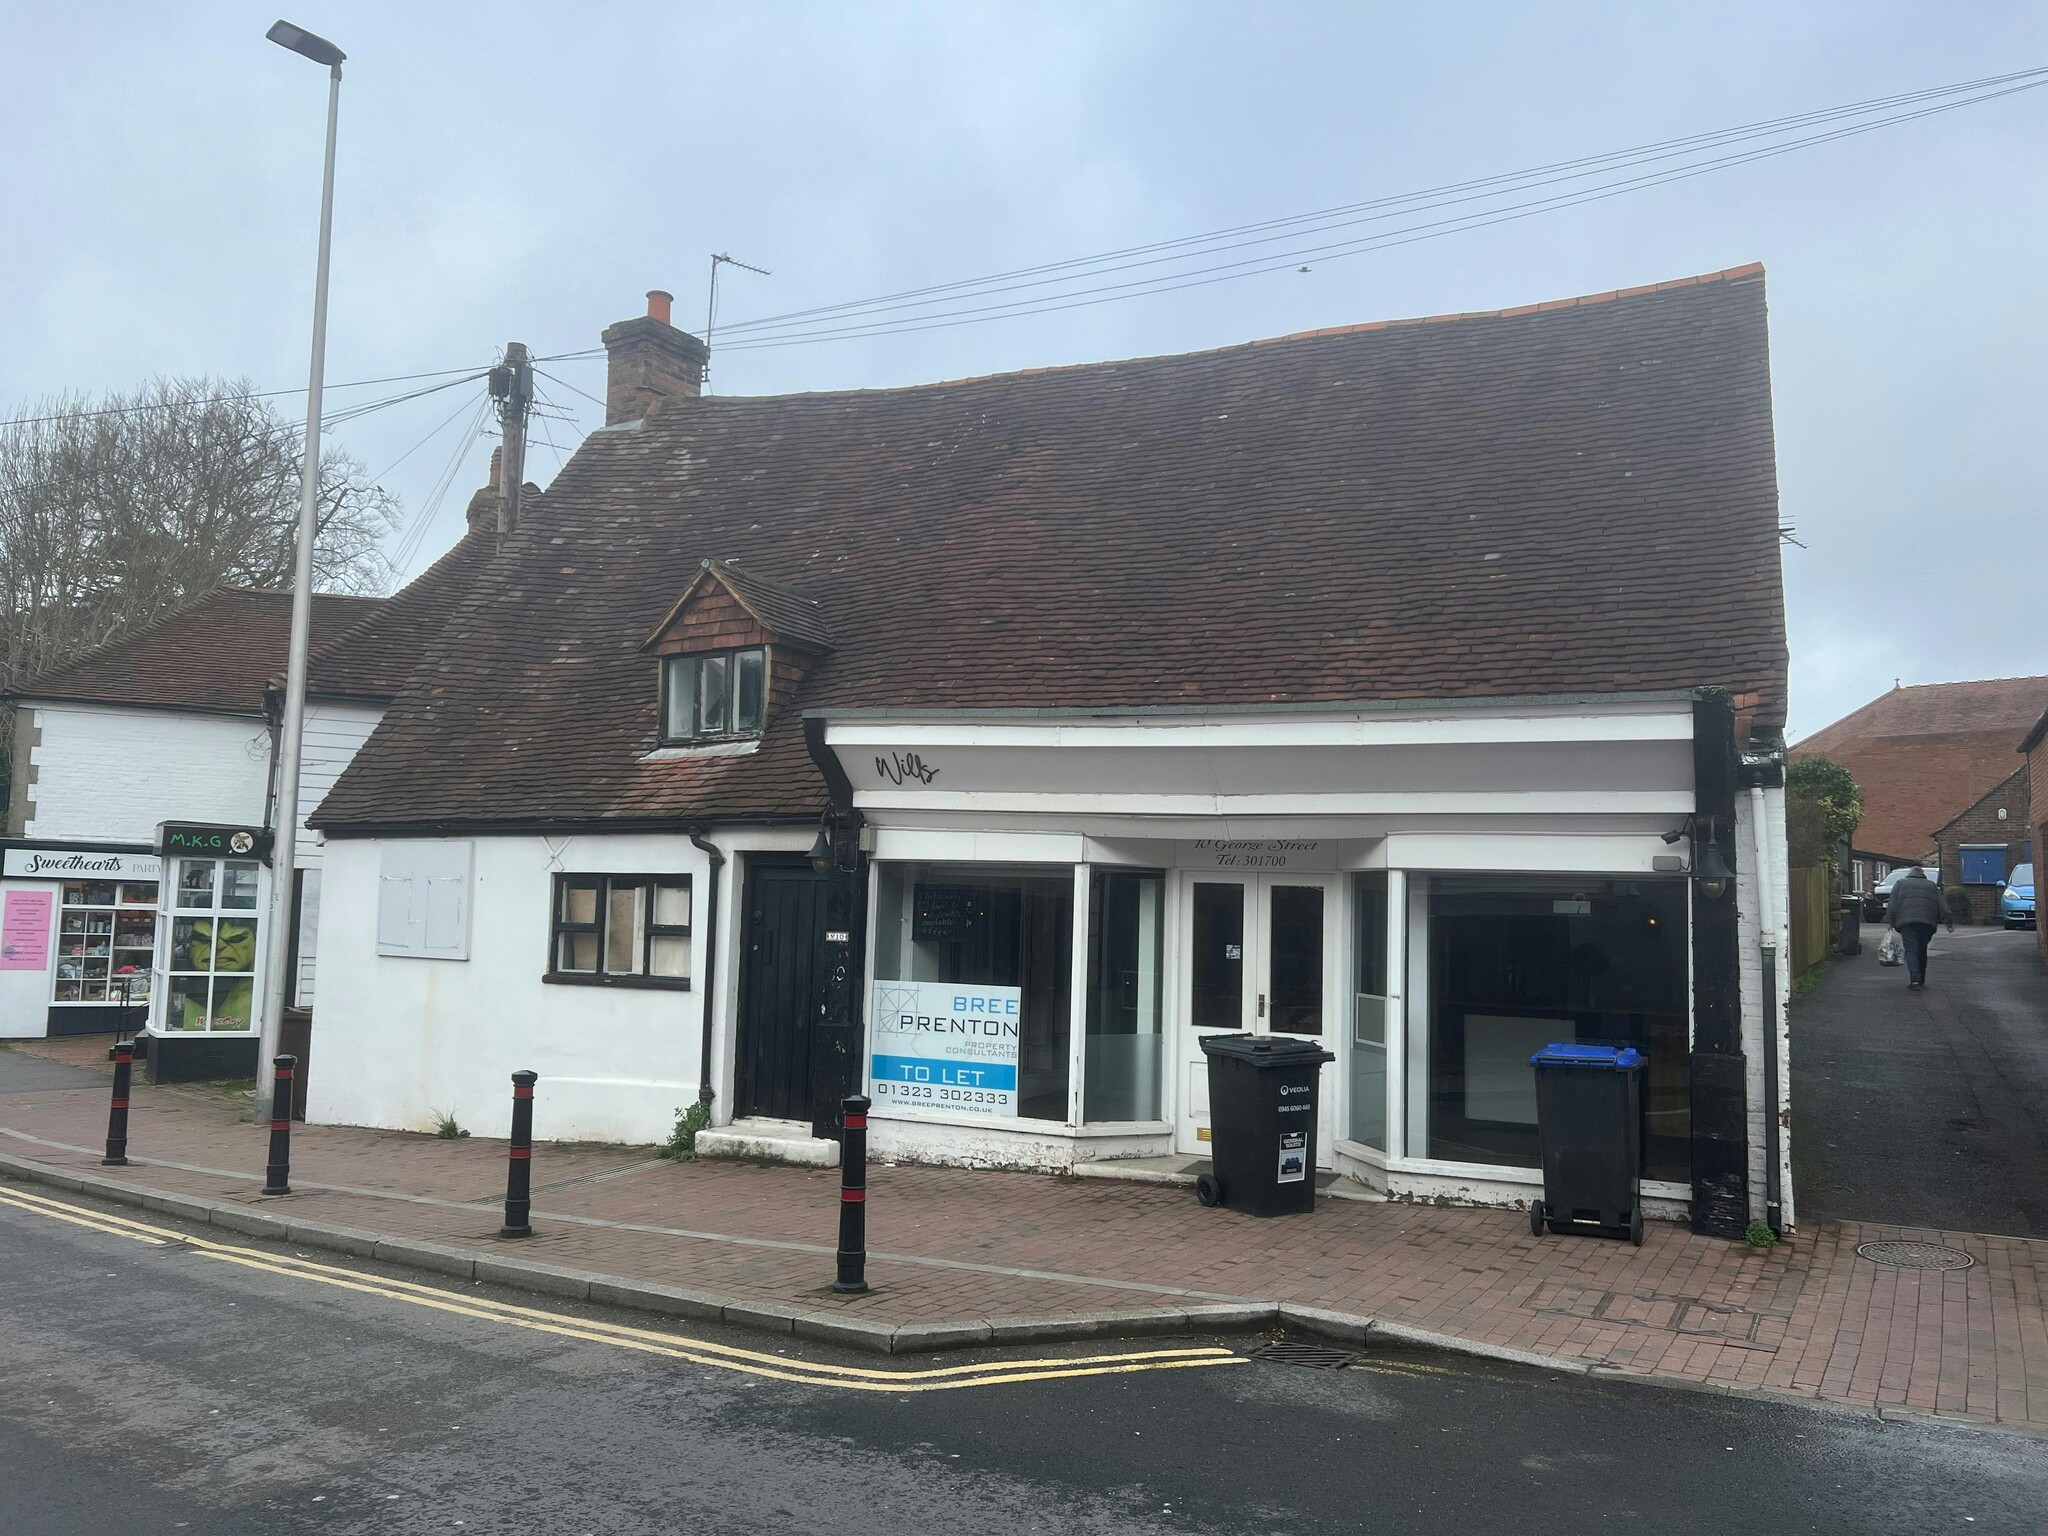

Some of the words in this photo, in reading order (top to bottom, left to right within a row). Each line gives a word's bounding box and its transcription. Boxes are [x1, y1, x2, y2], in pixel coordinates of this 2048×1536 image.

[1194, 840, 1211, 849] 10
[1215, 840, 1263, 852] George
[1268, 840, 1318, 851] Street
[24, 854, 123, 873] Sweethearts
[1216, 854, 1241, 866] Tel:
[1242, 855, 1286, 867] 301700
[953, 996, 1018, 1015] BREE
[900, 1015, 1018, 1038] PRENTON
[945, 1047, 1018, 1059] CONSULTANTS
[964, 1041, 1018, 1050] PROPERTY
[900, 1064, 930, 1082] TO
[942, 1068, 985, 1086] LET
[878, 1083, 932, 1098] 01323
[940, 1089, 1008, 1105] 302333
